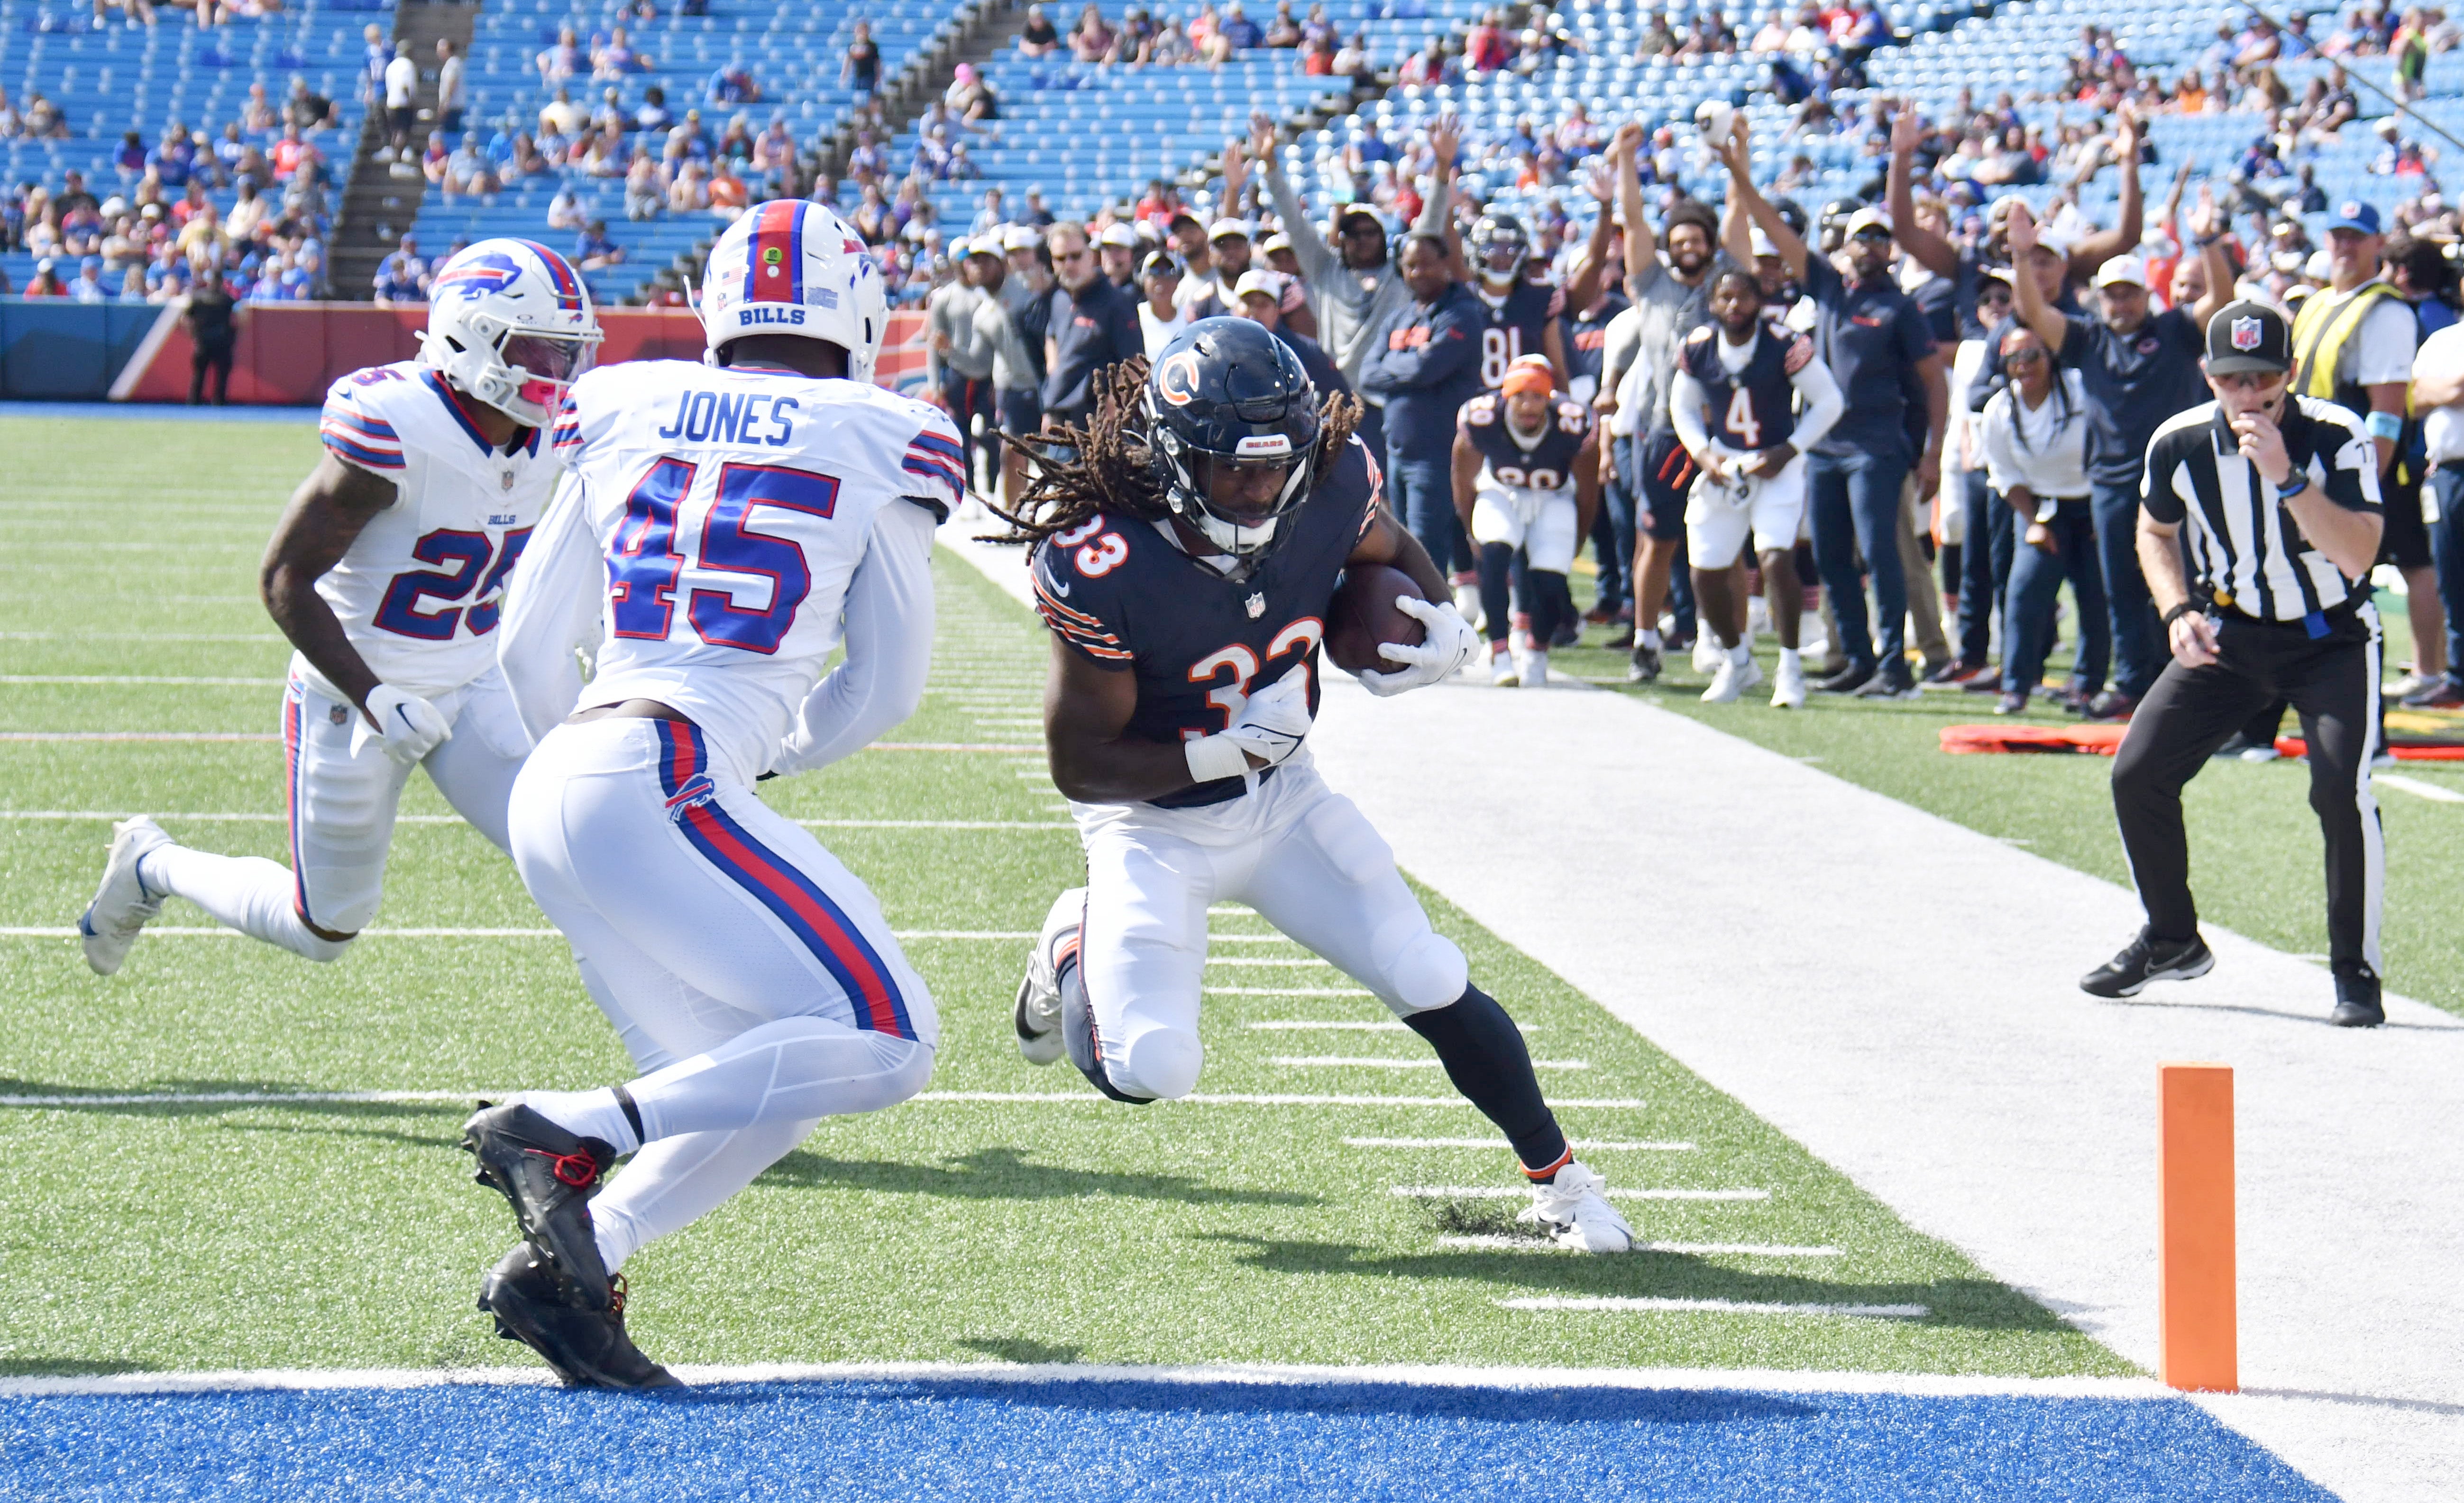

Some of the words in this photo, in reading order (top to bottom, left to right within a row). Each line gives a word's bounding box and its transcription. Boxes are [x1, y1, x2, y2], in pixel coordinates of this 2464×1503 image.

[739, 308, 805, 326] BILLS
[1481, 326, 1522, 390] 81
[659, 390, 799, 446] JONES
[1246, 435, 1283, 448] BEARS
[1726, 385, 1761, 447] 4
[487, 514, 516, 525] BILLS
[373, 525, 536, 640] 25
[605, 456, 841, 655] 45
